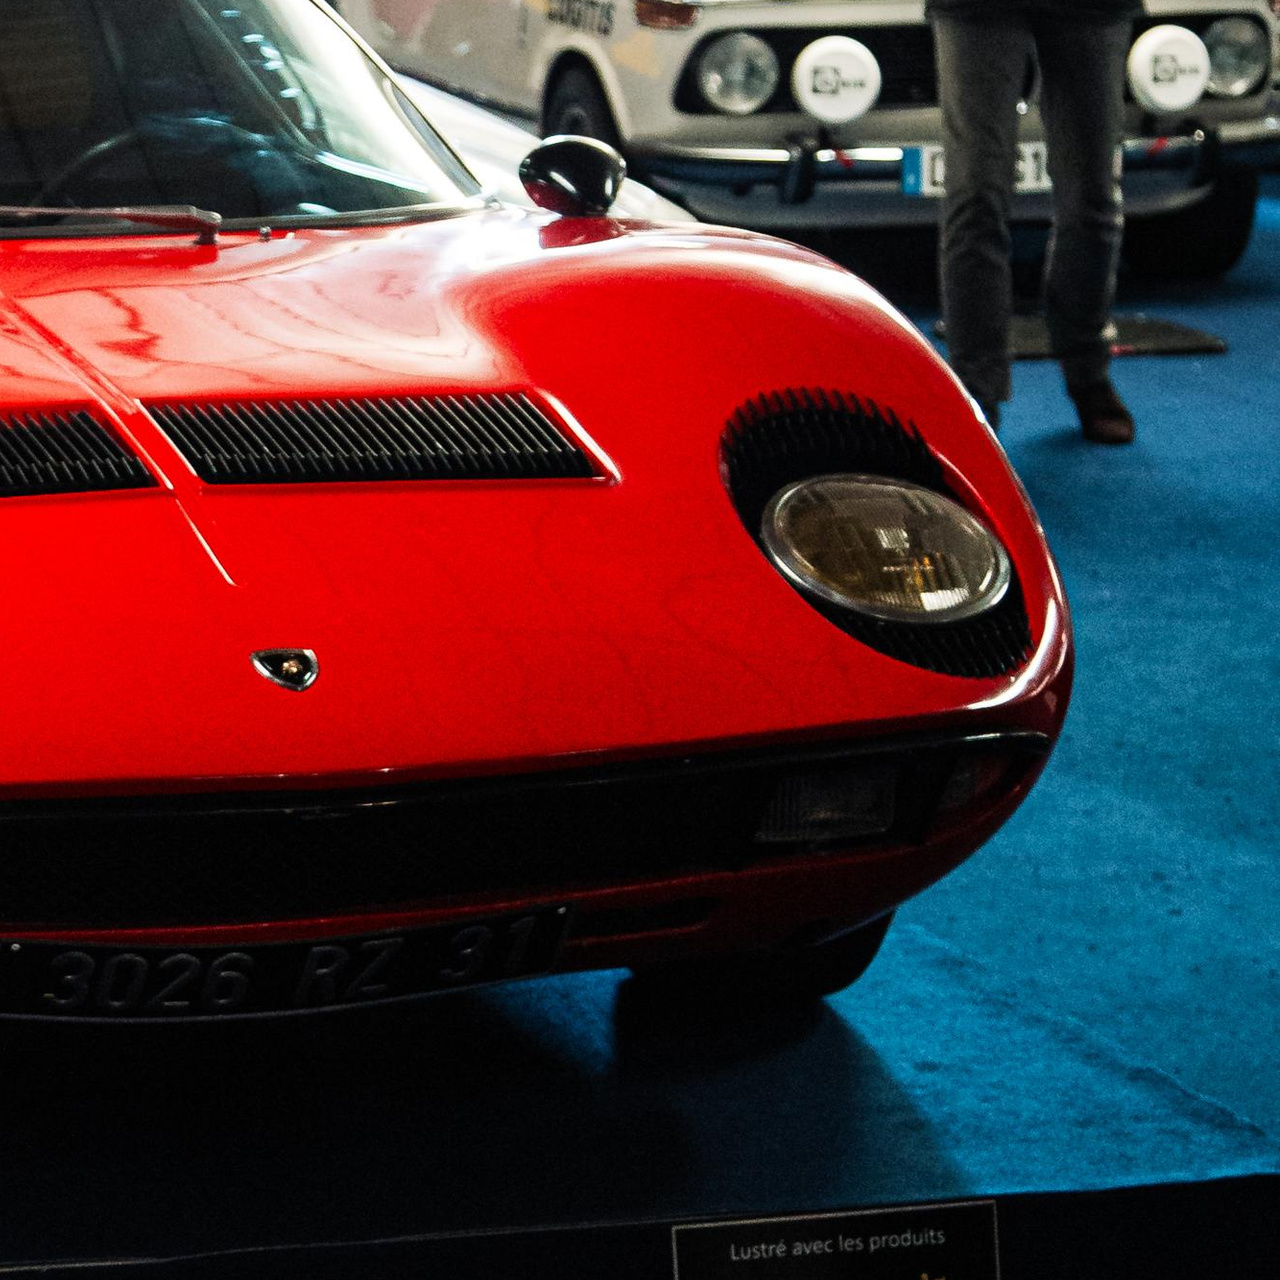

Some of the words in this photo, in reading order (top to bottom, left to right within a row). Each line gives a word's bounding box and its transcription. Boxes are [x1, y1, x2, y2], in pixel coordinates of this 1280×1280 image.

[42, 949, 257, 1009] 3026
[291, 936, 405, 1005] RZ
[440, 914, 539, 982] 31
[730, 1238, 787, 1262] Lustré
[791, 1238, 835, 1257] avec
[838, 1232, 865, 1253] les
[869, 1226, 947, 1254] produits
